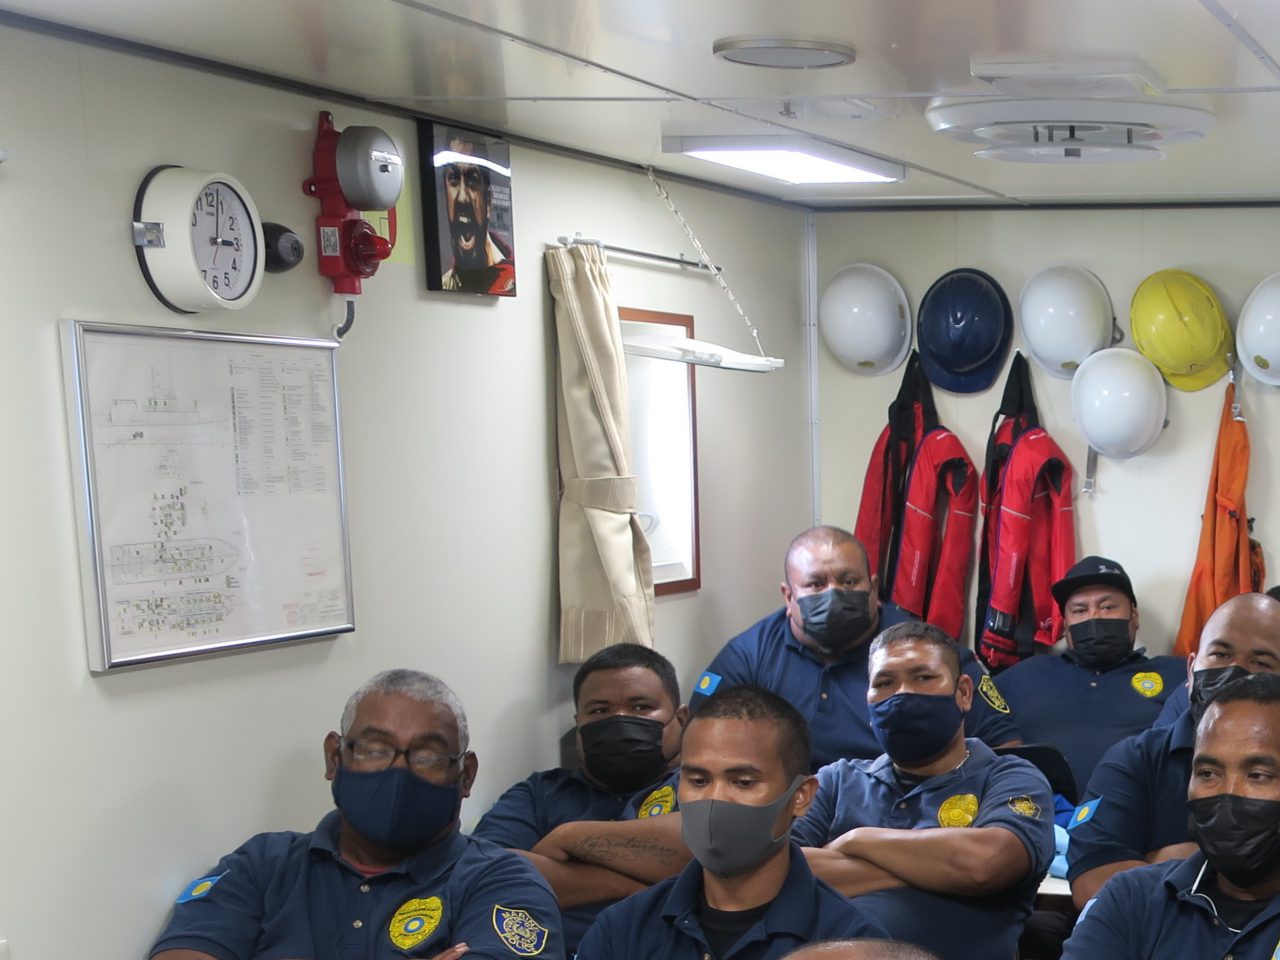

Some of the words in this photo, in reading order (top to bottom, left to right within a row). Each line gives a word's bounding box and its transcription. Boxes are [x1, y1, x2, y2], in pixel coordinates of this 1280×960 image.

[205, 191, 215, 208] 12
[228, 216, 235, 230] 2
[231, 257, 237, 271] 4
[212, 275, 219, 290] 6
[224, 272, 230, 287] 5
